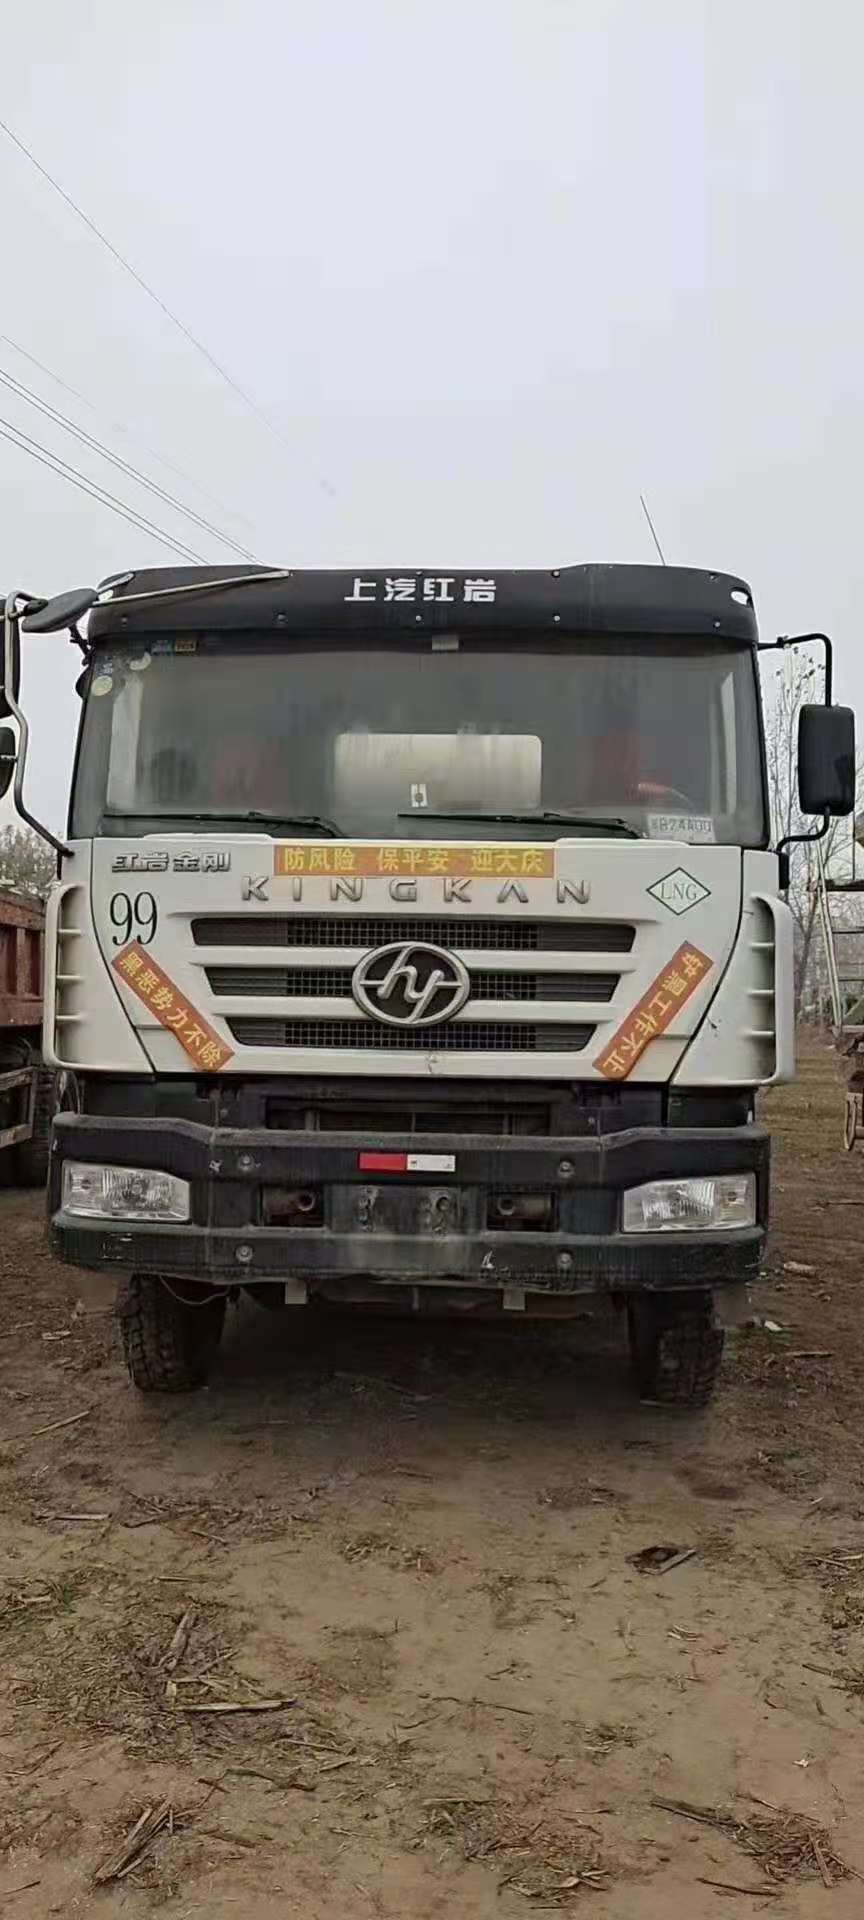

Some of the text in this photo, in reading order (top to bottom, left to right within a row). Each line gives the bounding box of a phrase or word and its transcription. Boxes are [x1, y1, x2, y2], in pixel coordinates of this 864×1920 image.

[344, 577, 496, 602] 上汽红岩
[112, 852, 230, 872] 红岩金刚
[284, 848, 545, 872] 防风险 保平安 迎大庆
[241, 876, 592, 903] KINGKAN
[660, 883, 698, 900] LNG
[110, 892, 157, 945] 99
[120, 952, 221, 1067] 黑恶势力不除
